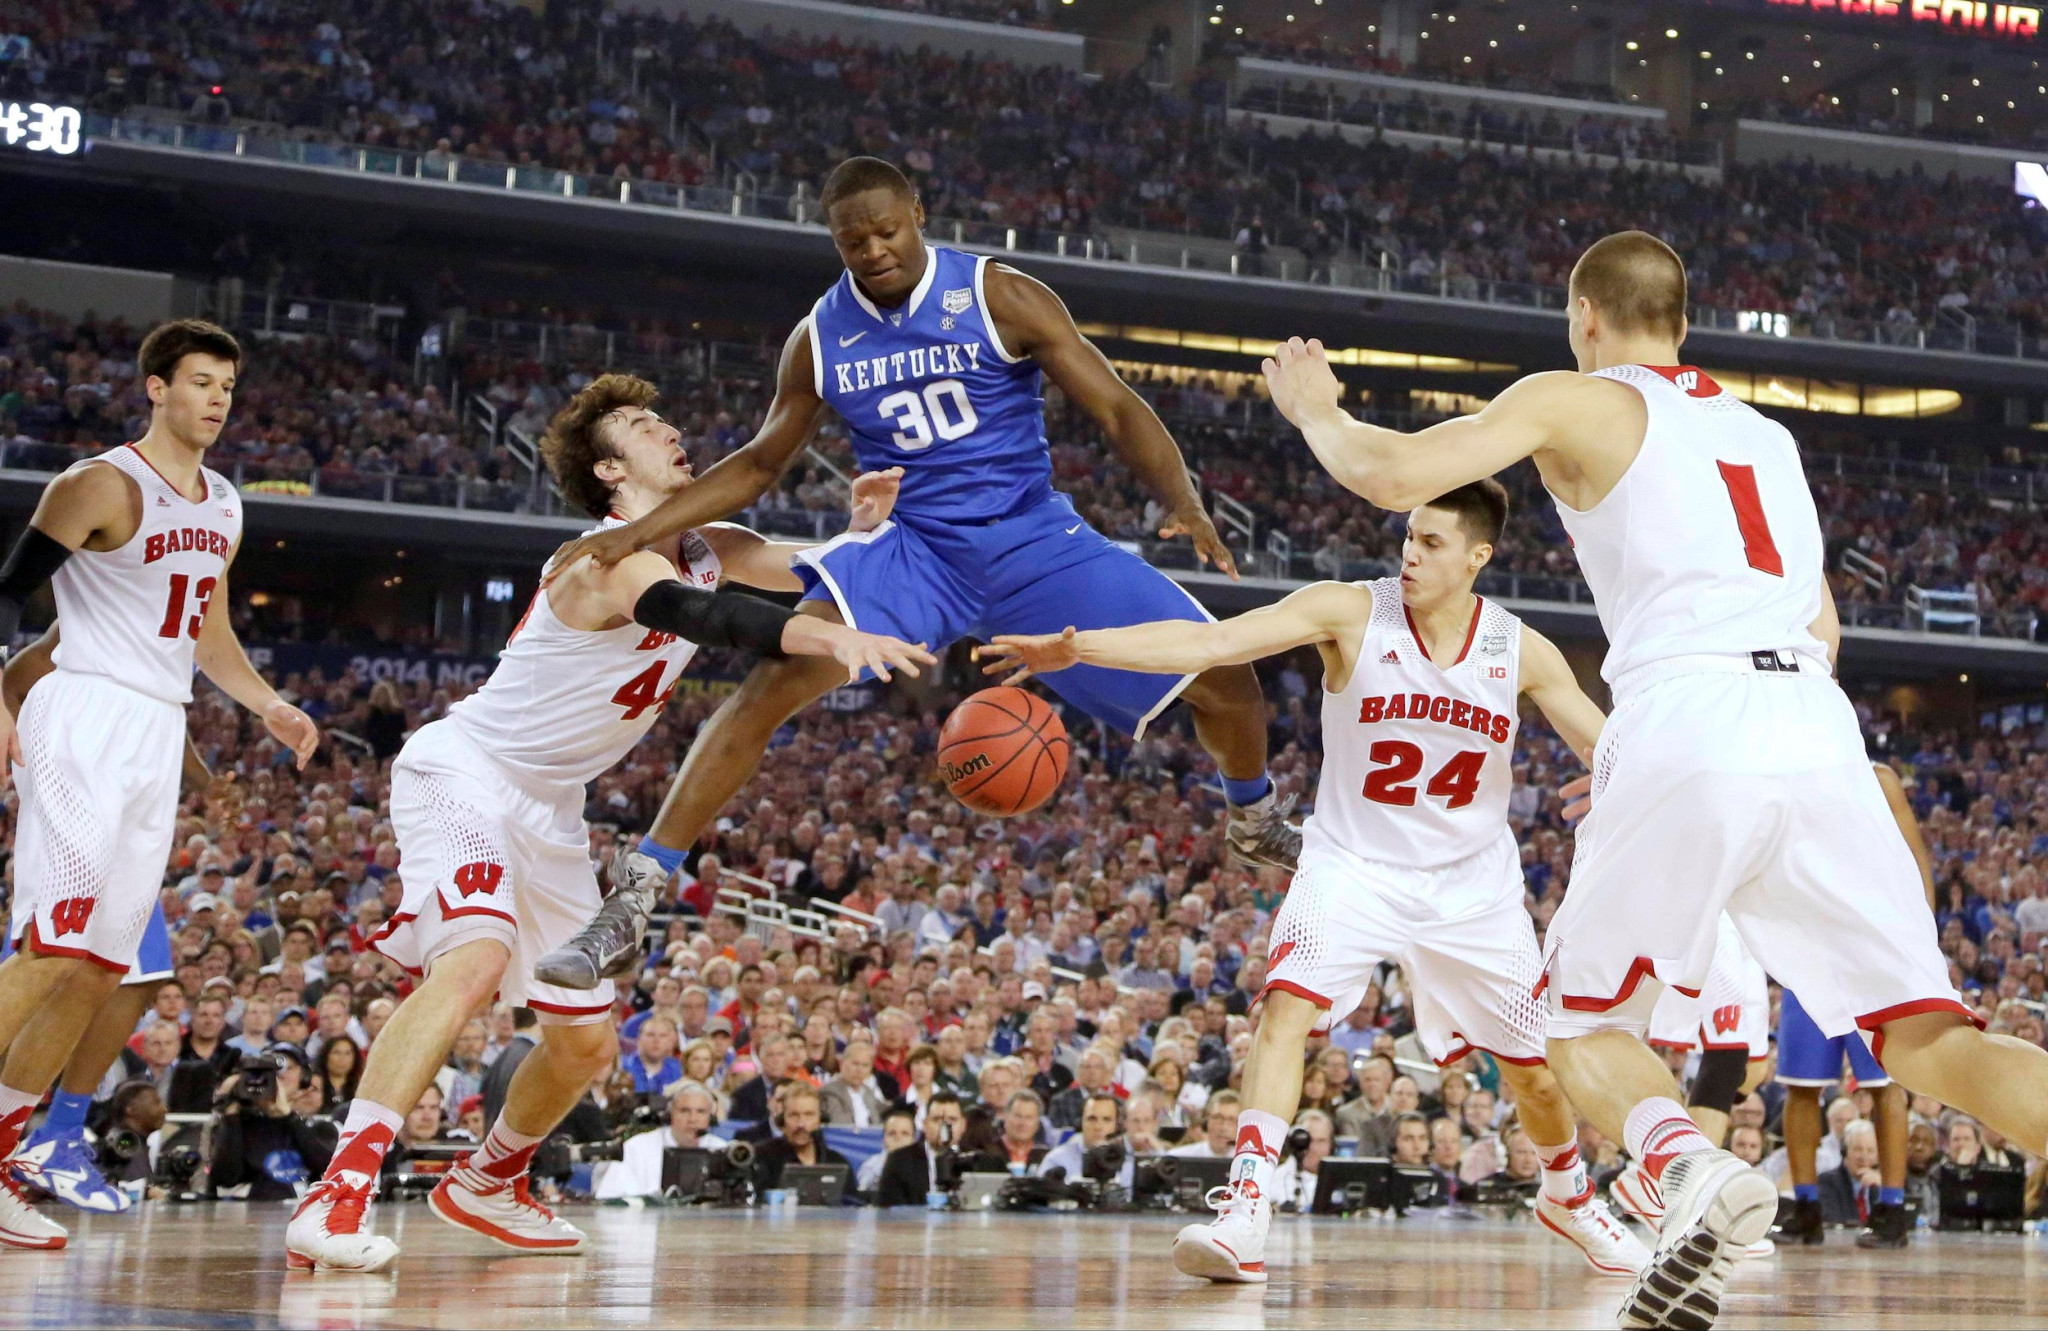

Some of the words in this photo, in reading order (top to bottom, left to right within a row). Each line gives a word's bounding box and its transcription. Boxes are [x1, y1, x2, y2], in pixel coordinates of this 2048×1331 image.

[834, 342, 980, 394] KENTUCKY
[877, 379, 978, 451] 30
[1716, 459, 1784, 577] 1
[143, 527, 232, 565] BADGER
[158, 573, 217, 640] 13
[351, 655, 430, 684] 2014
[1358, 693, 1511, 744] BADGERS
[944, 752, 990, 783] ilson
[1362, 740, 1488, 809] 24
[454, 861, 504, 899] W
[50, 896, 96, 939] W
[1713, 1004, 1740, 1036] W
